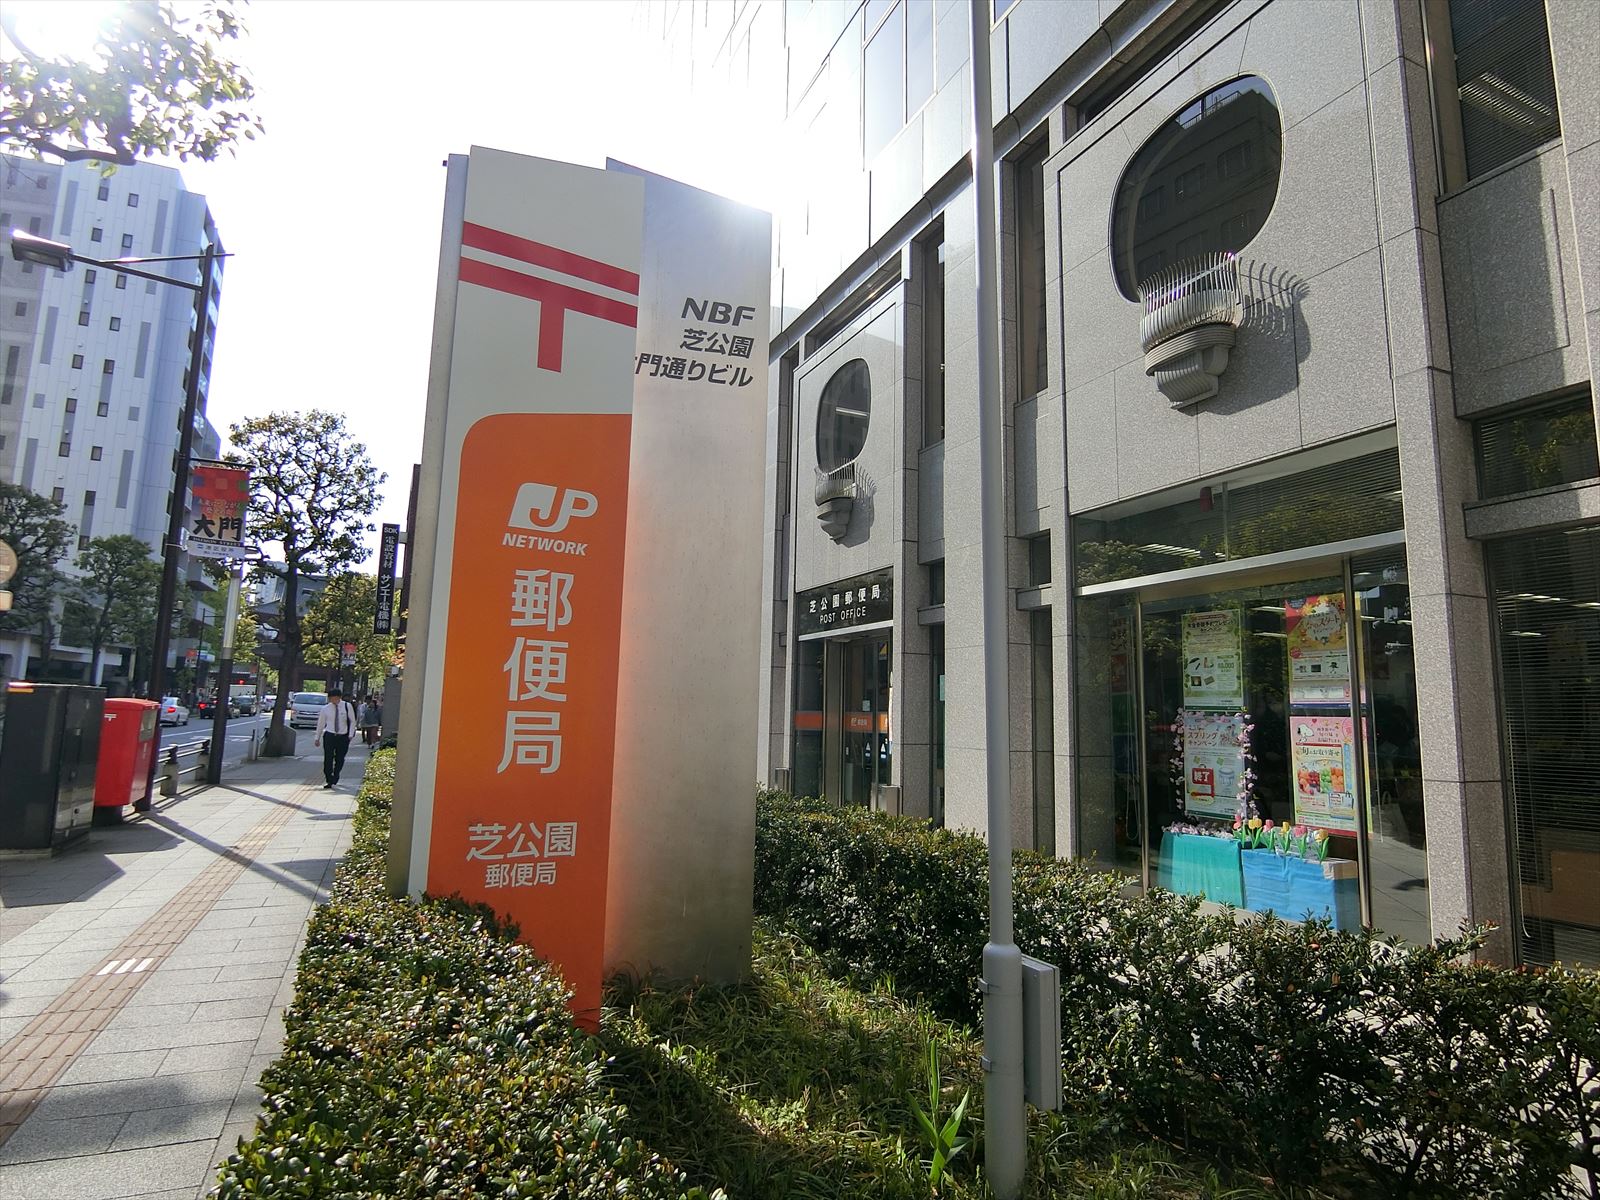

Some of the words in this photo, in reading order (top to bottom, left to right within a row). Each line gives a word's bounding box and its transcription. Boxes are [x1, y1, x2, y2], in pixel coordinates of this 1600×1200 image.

[681, 297, 756, 326] NBF
[680, 328, 754, 358] 芝公園
[635, 352, 754, 387] 門通りビル
[508, 482, 598, 533] JP
[193, 514, 242, 541] 大門
[384, 526, 398, 534] SDK
[384, 536, 395, 568] 電設資材
[502, 532, 588, 556] NETWORK
[809, 584, 880, 613] 芝公園郵便局
[820, 612, 836, 624] POST
[841, 606, 867, 620] OFFICE
[497, 569, 575, 774] 郵便局
[466, 822, 578, 862] 芝公園
[484, 862, 557, 889] 郵便局
